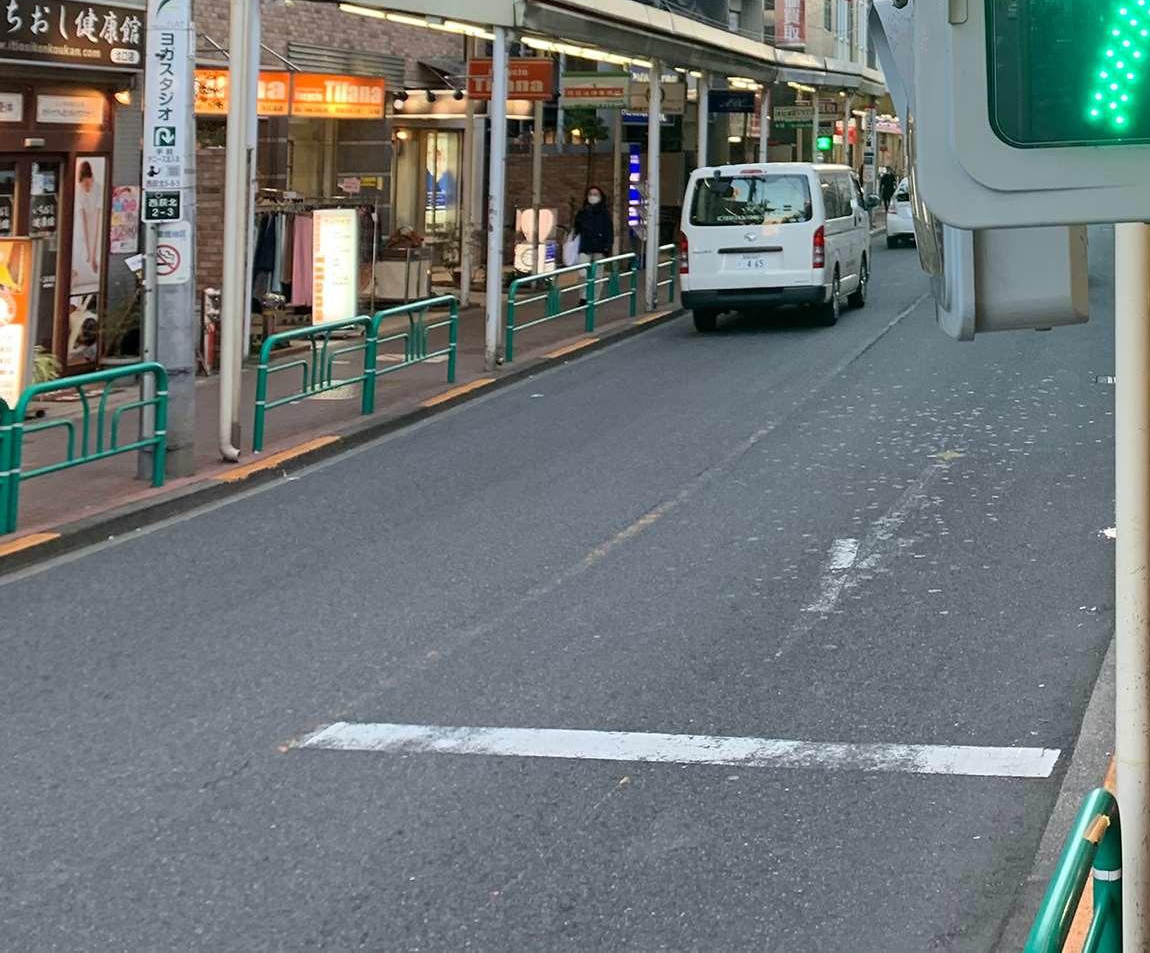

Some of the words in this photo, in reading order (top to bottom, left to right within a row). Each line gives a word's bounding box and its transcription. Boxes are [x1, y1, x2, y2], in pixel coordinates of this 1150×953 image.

[148, 198, 177, 208] 西荻北
[151, 208, 174, 217] 2-3
